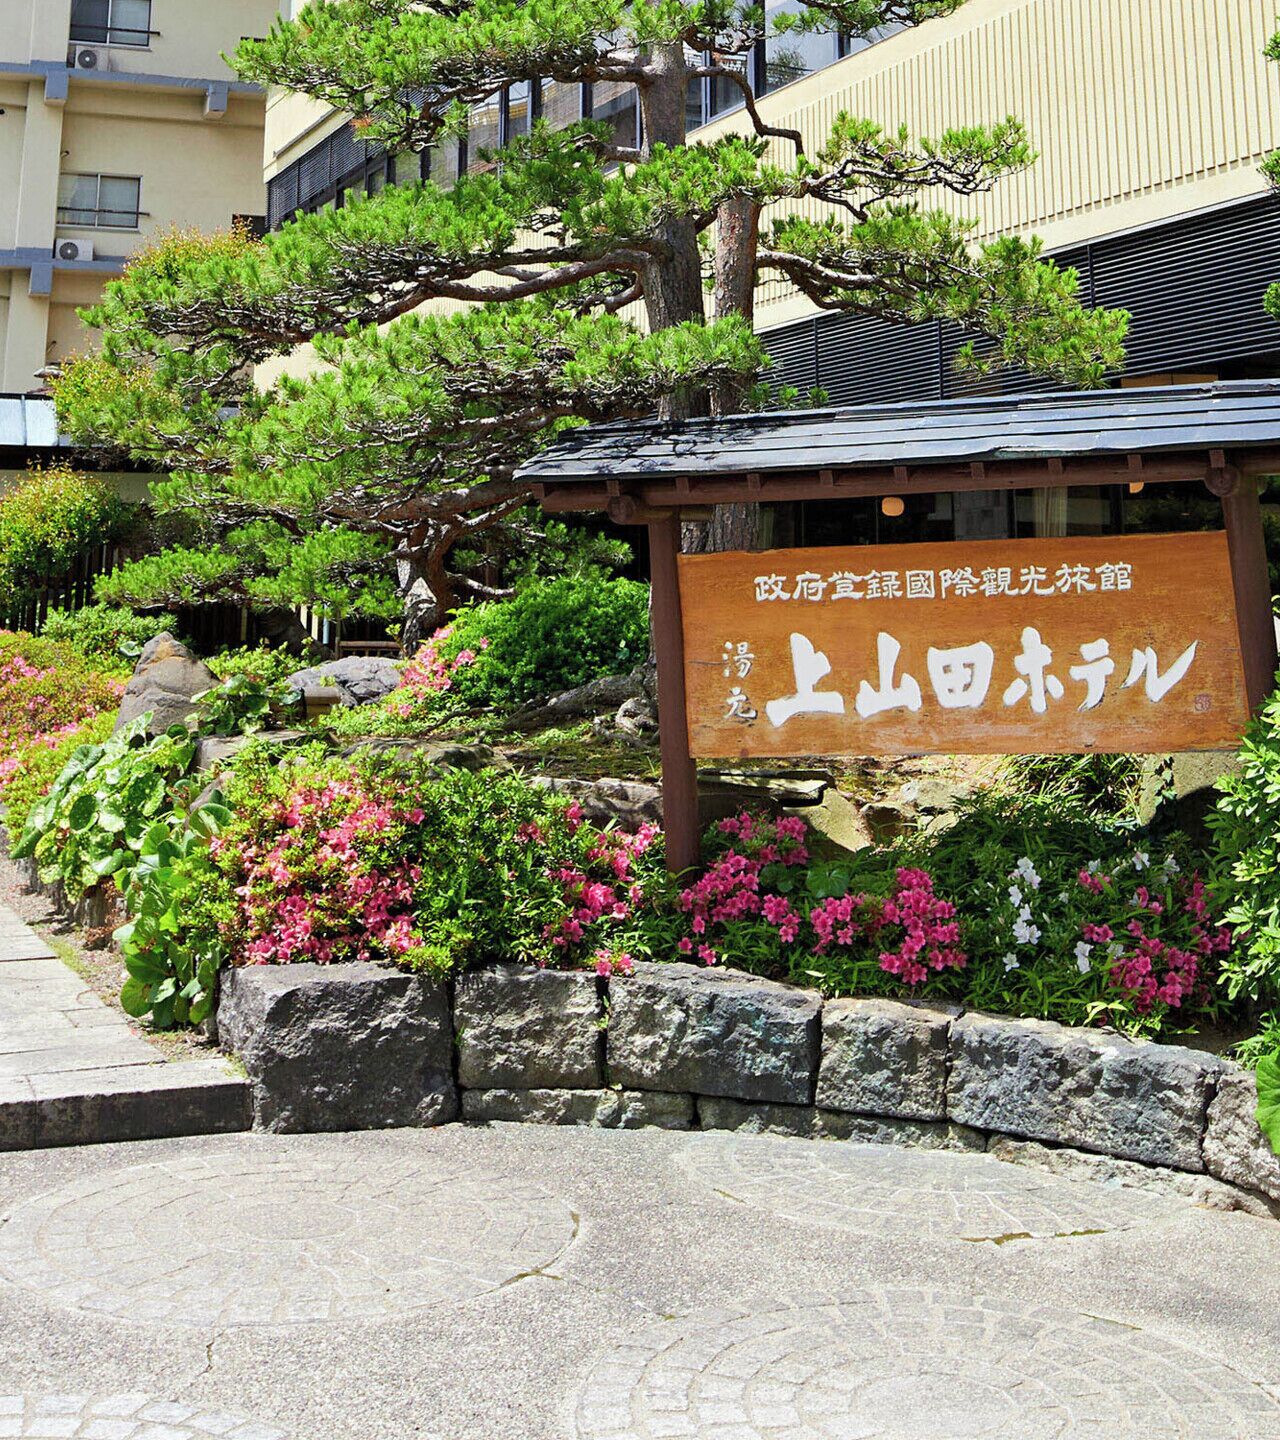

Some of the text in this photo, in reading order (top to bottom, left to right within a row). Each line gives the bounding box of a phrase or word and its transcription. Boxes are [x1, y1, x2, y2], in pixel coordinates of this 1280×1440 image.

[722, 641, 758, 720] 湯元
[765, 626, 1201, 729] 上山田ホテル
